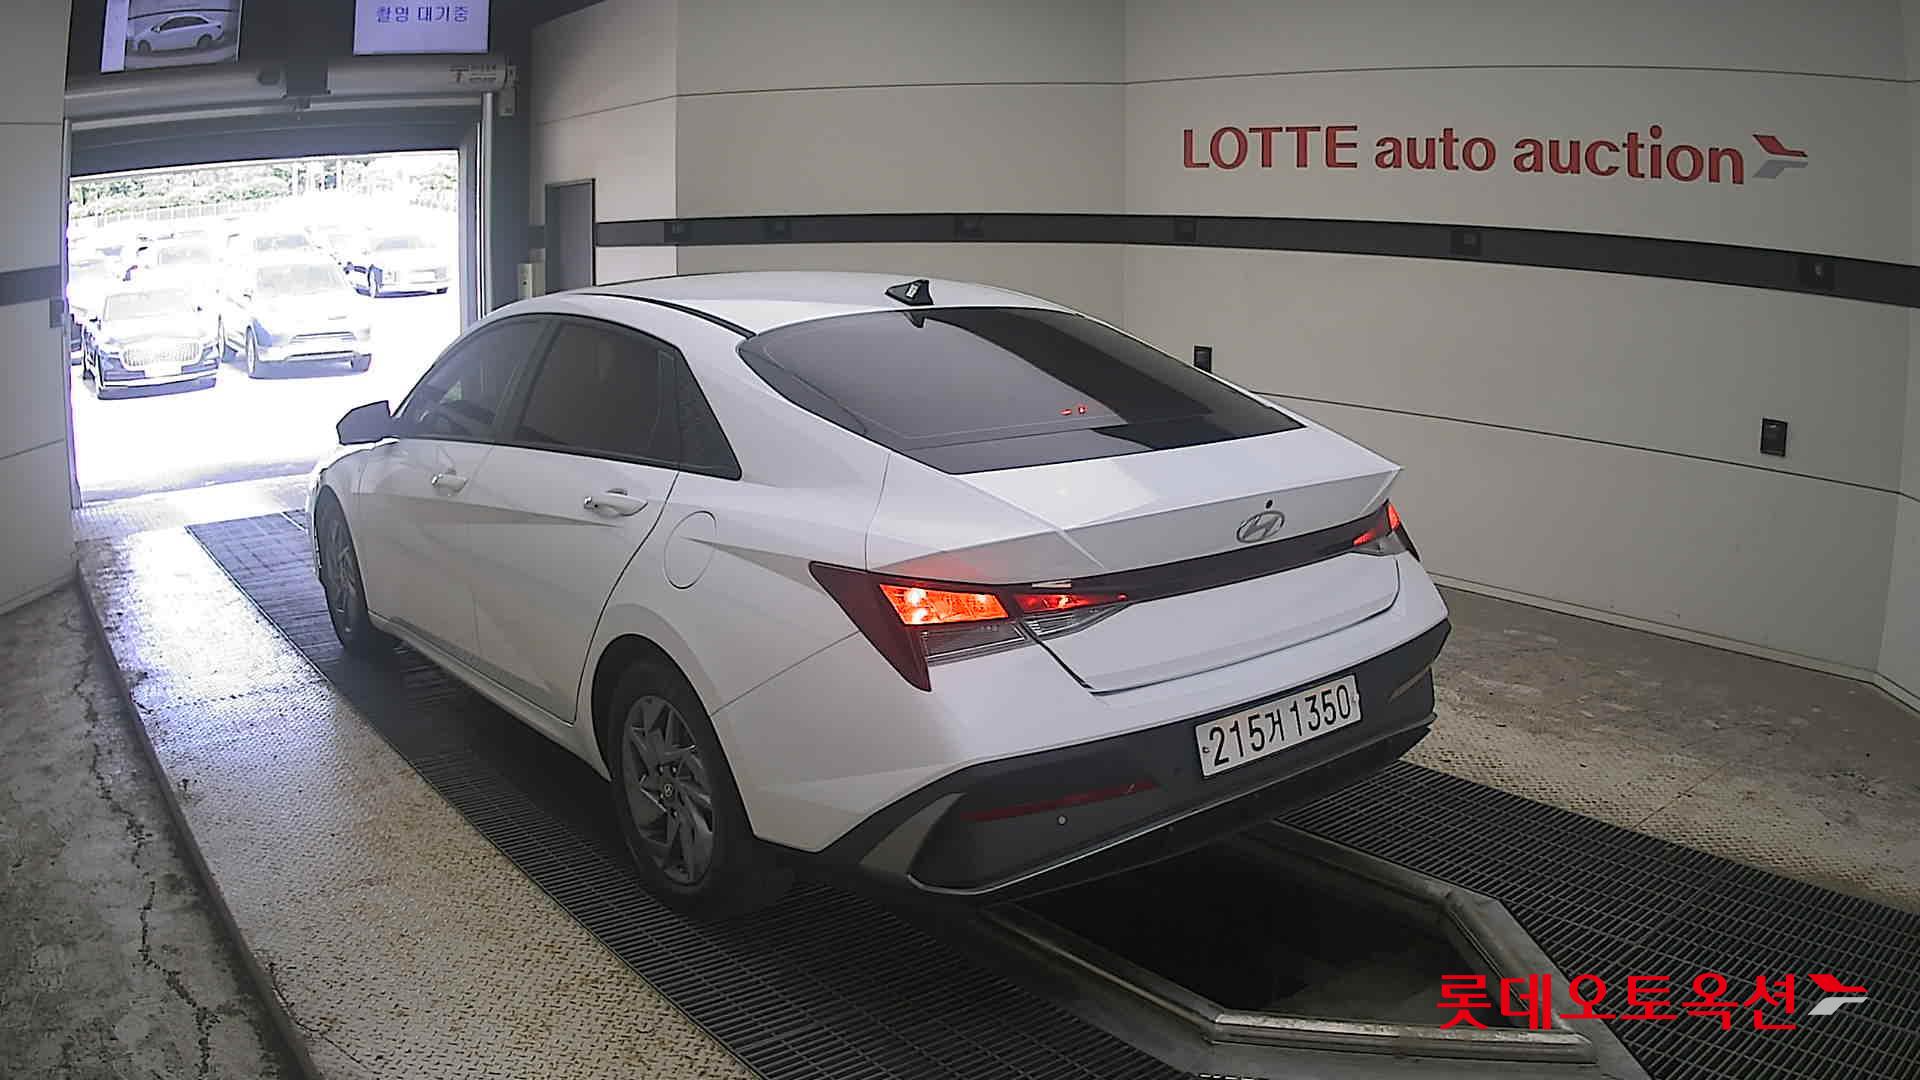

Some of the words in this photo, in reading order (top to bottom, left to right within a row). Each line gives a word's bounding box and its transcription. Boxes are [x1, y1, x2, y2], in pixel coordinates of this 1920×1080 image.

[417, 5, 469, 23] 대기중
[1183, 125, 1358, 170] LOTTE
[1375, 127, 1497, 174] auto
[1513, 124, 1745, 185] auction
[1209, 708, 1285, 766] 215거
[1289, 684, 1351, 737] 1350
